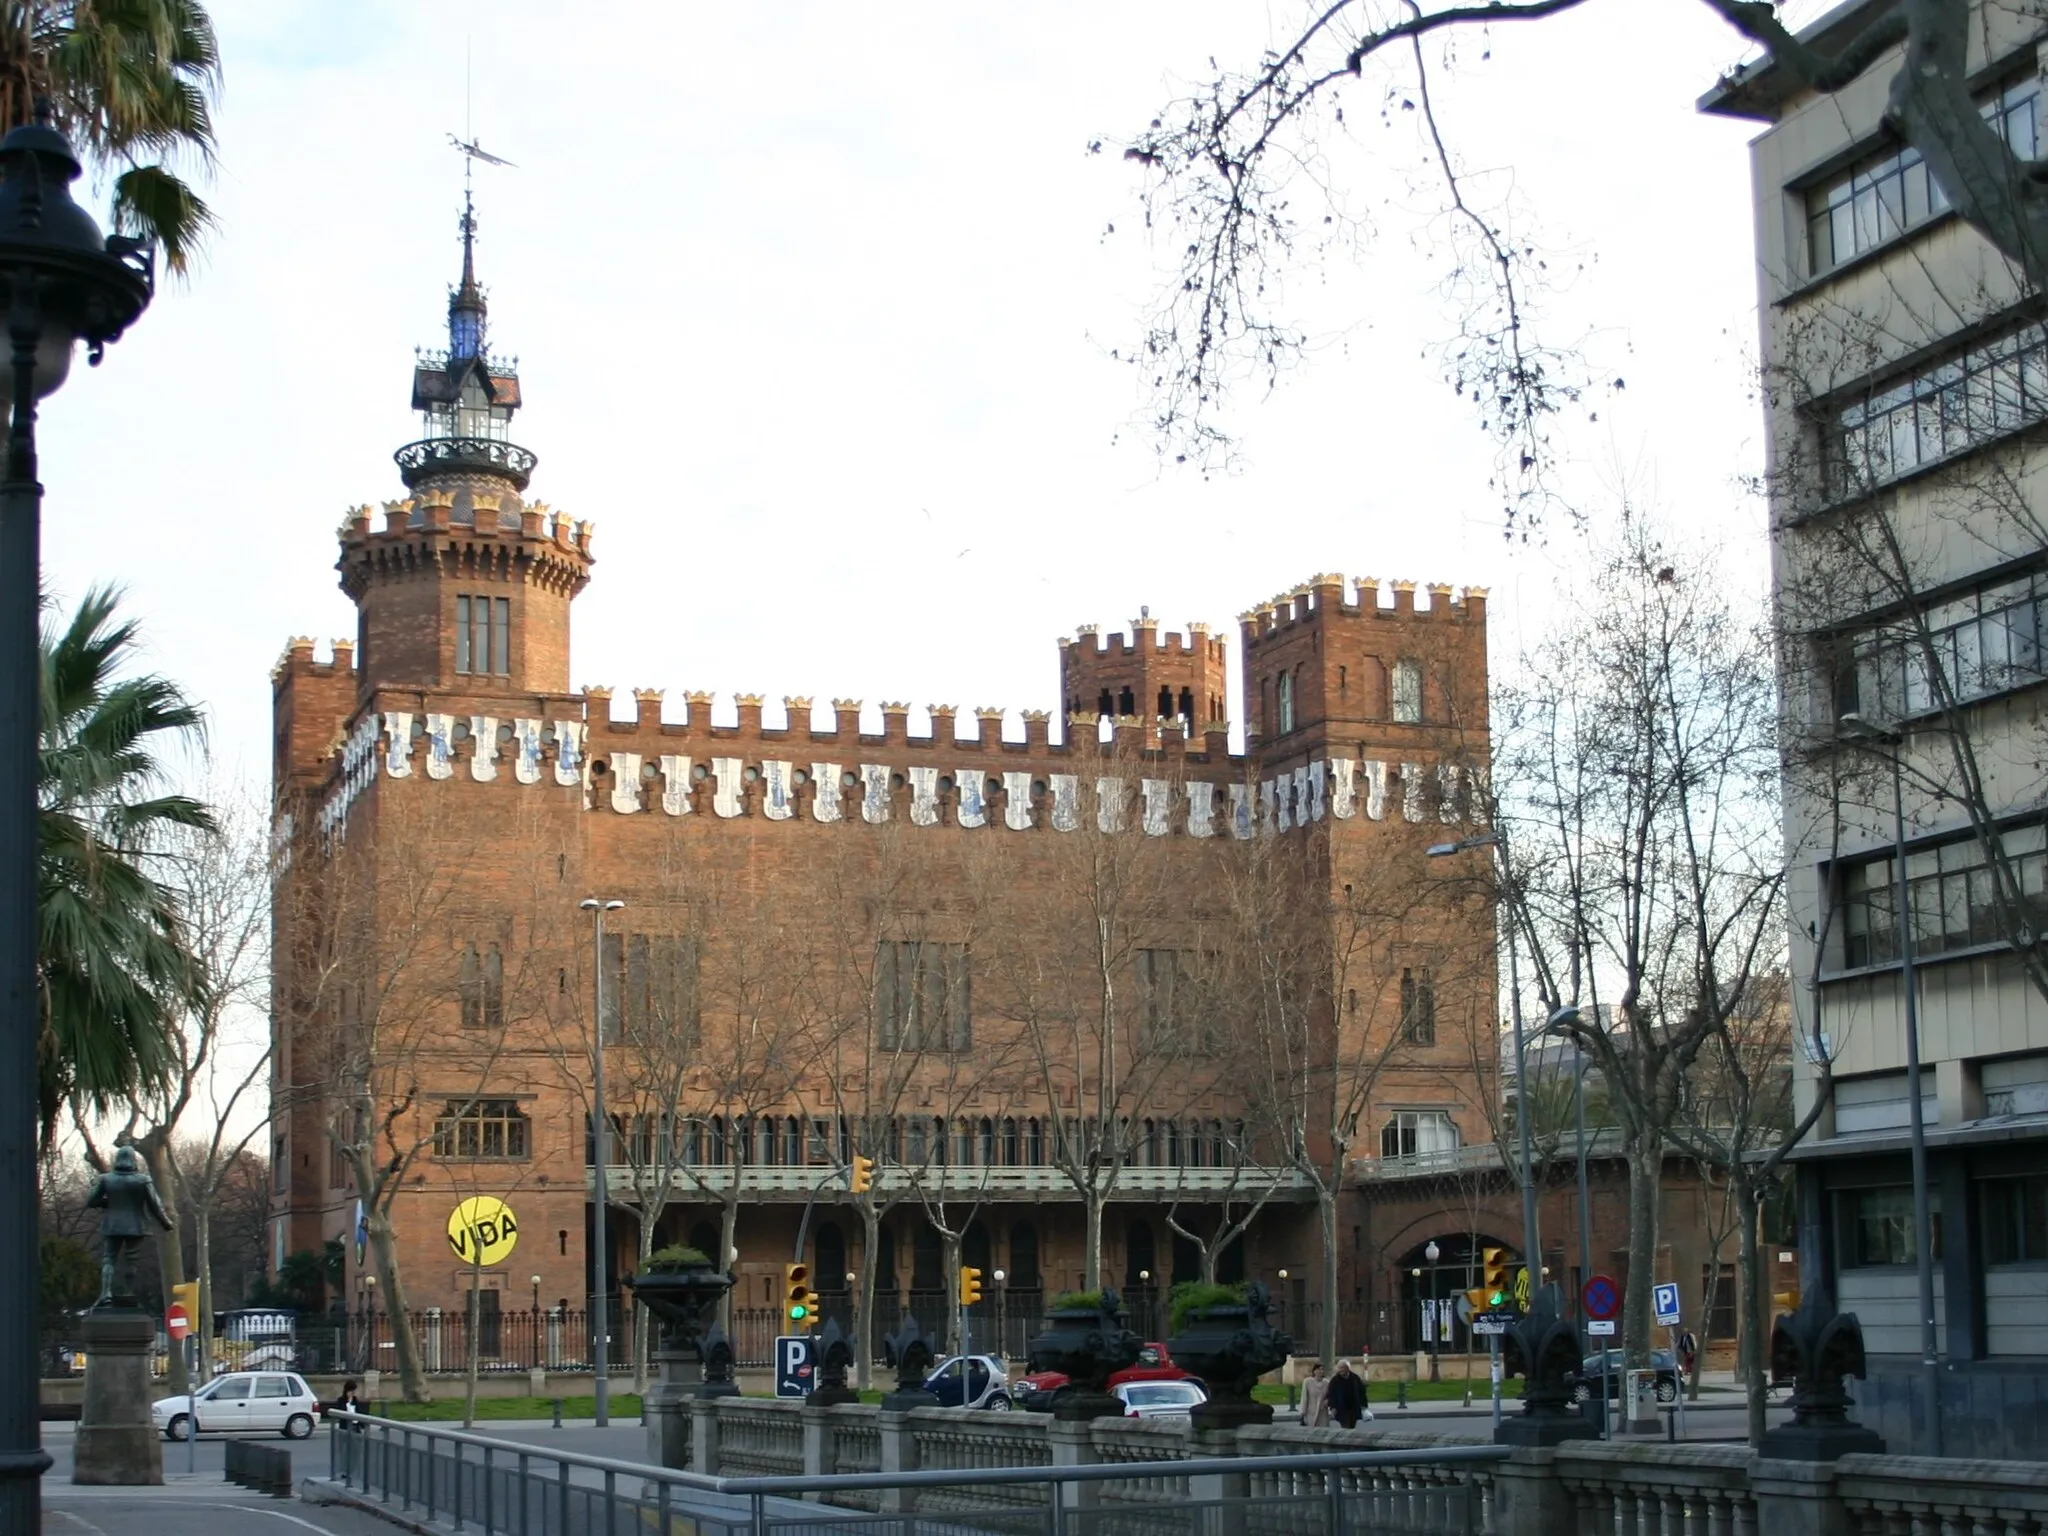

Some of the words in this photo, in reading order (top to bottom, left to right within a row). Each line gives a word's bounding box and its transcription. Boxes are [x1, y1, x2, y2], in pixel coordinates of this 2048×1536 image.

[448, 1214, 517, 1256] VIDA
[1658, 1289, 1672, 1313] P
[787, 1341, 806, 1375] P
